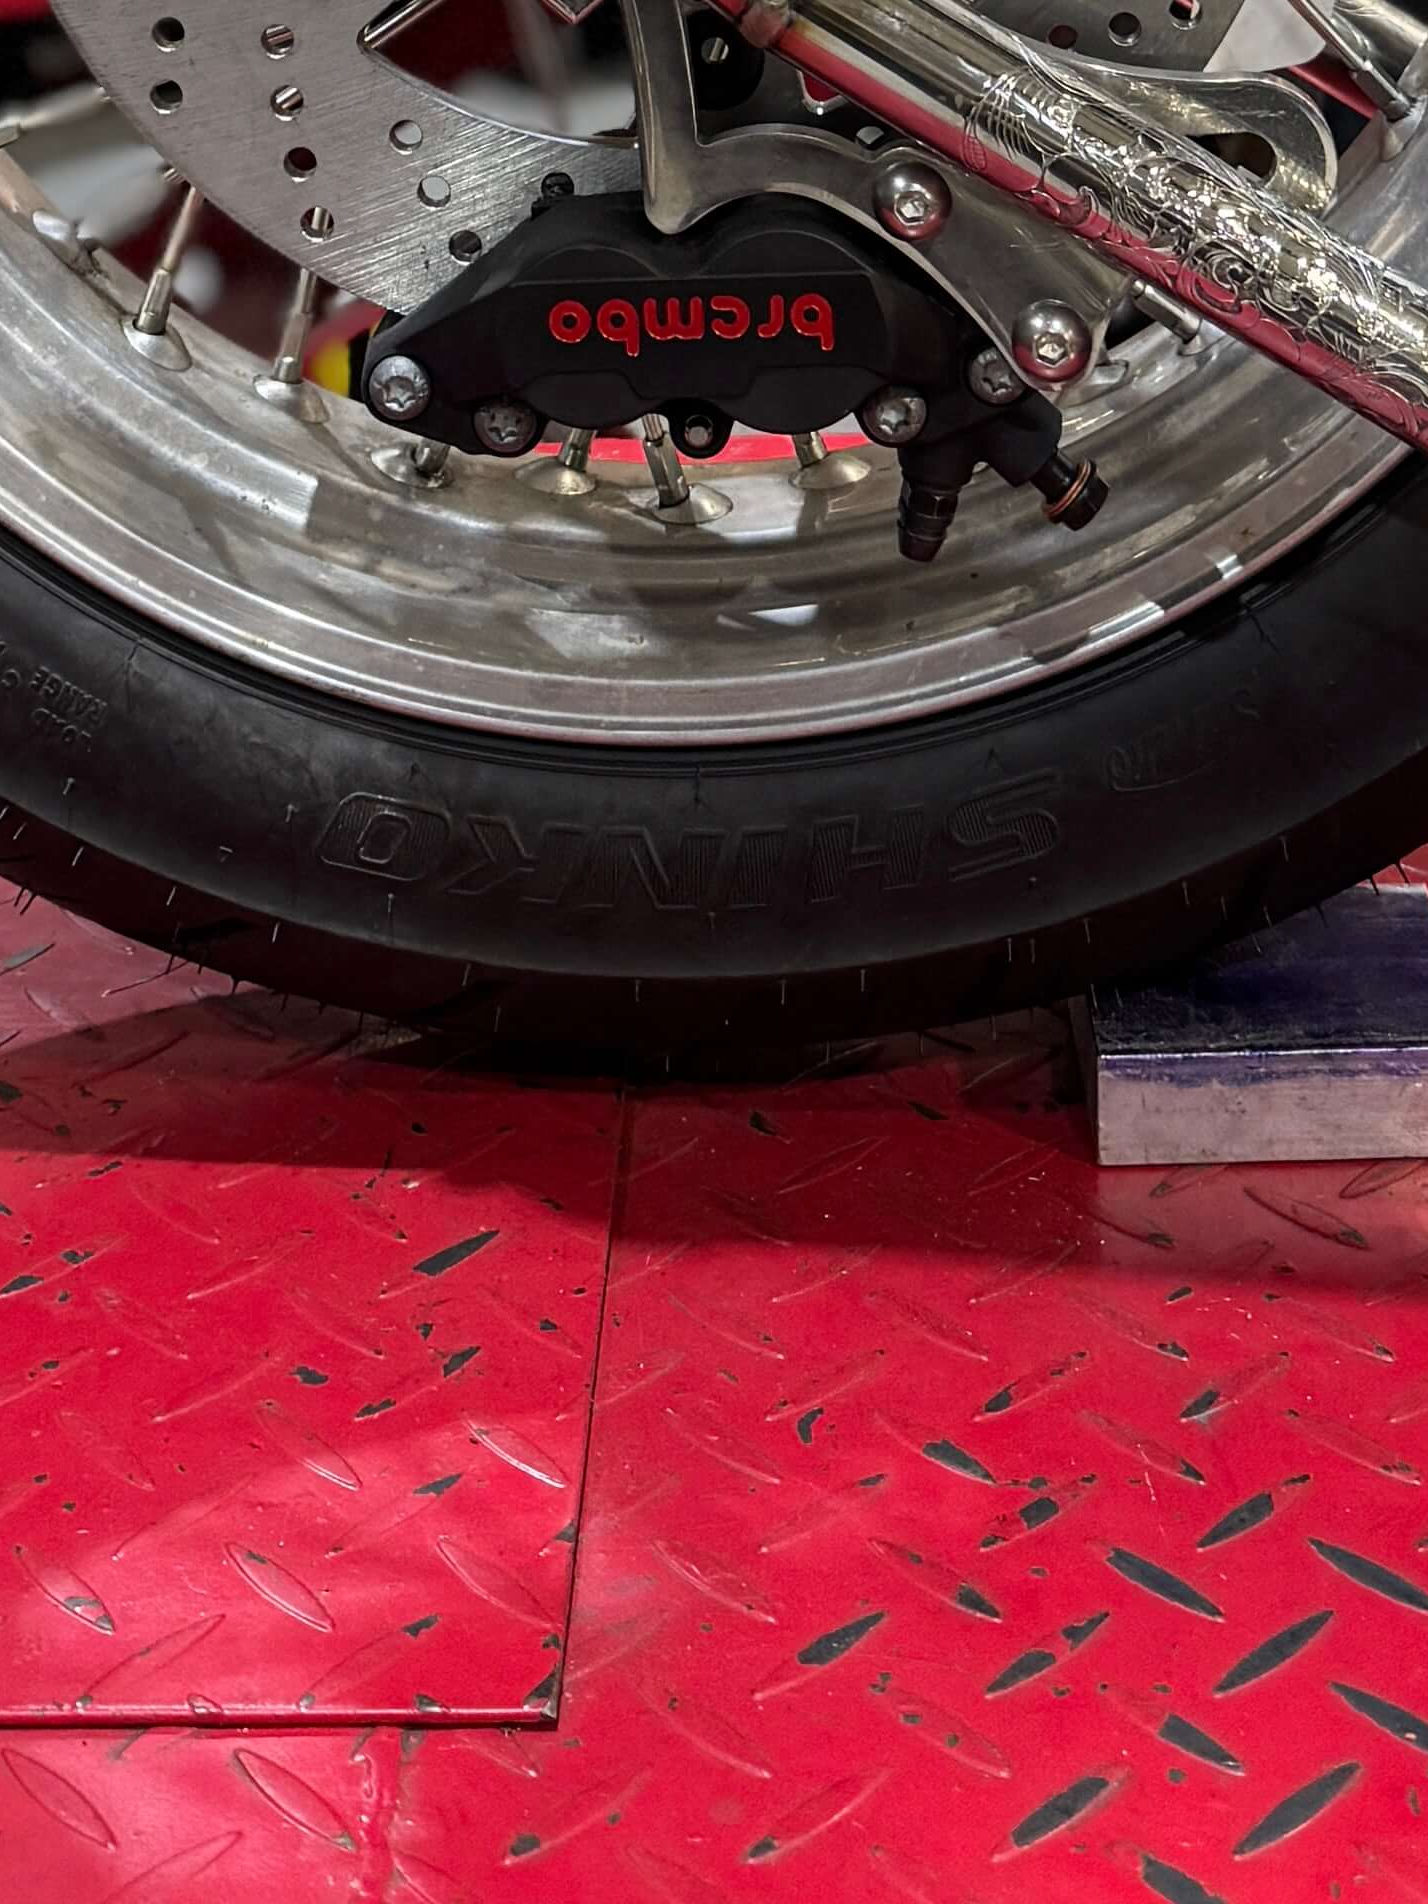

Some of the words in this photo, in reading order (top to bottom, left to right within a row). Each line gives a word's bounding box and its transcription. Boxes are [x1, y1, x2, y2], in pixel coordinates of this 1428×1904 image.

[548, 291, 836, 358] brembo
[30, 665, 108, 725] RANGE
[316, 767, 1065, 910] SHINKO
